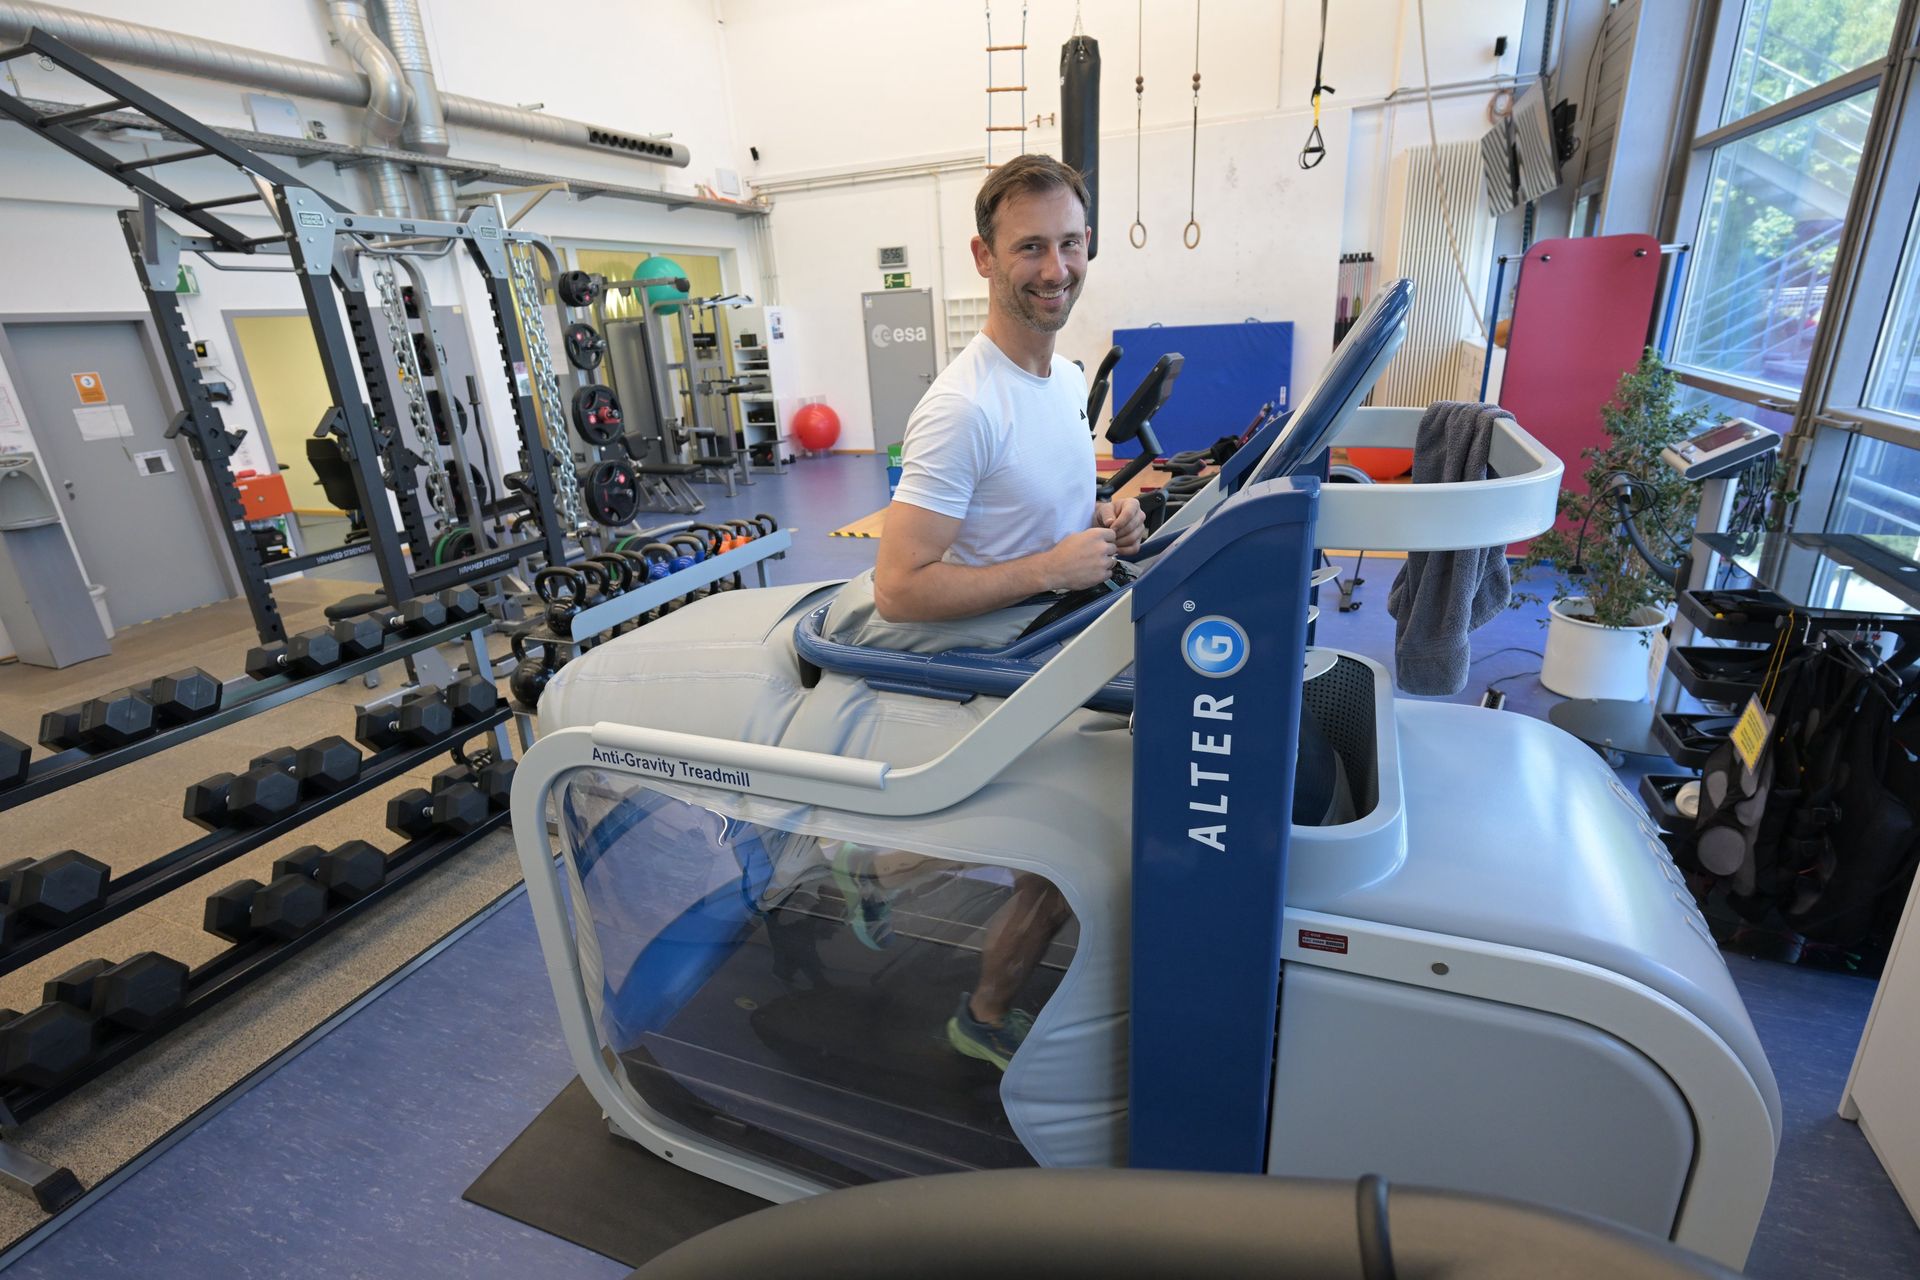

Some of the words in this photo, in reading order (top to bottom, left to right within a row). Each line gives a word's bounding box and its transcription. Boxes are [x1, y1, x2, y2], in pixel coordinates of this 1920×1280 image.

[893, 326, 926, 342] esa
[316, 551, 343, 565] HAMMER
[458, 560, 484, 576] HAMMER
[592, 747, 675, 777] Anti-Gravity
[679, 761, 750, 787] Treadmill
